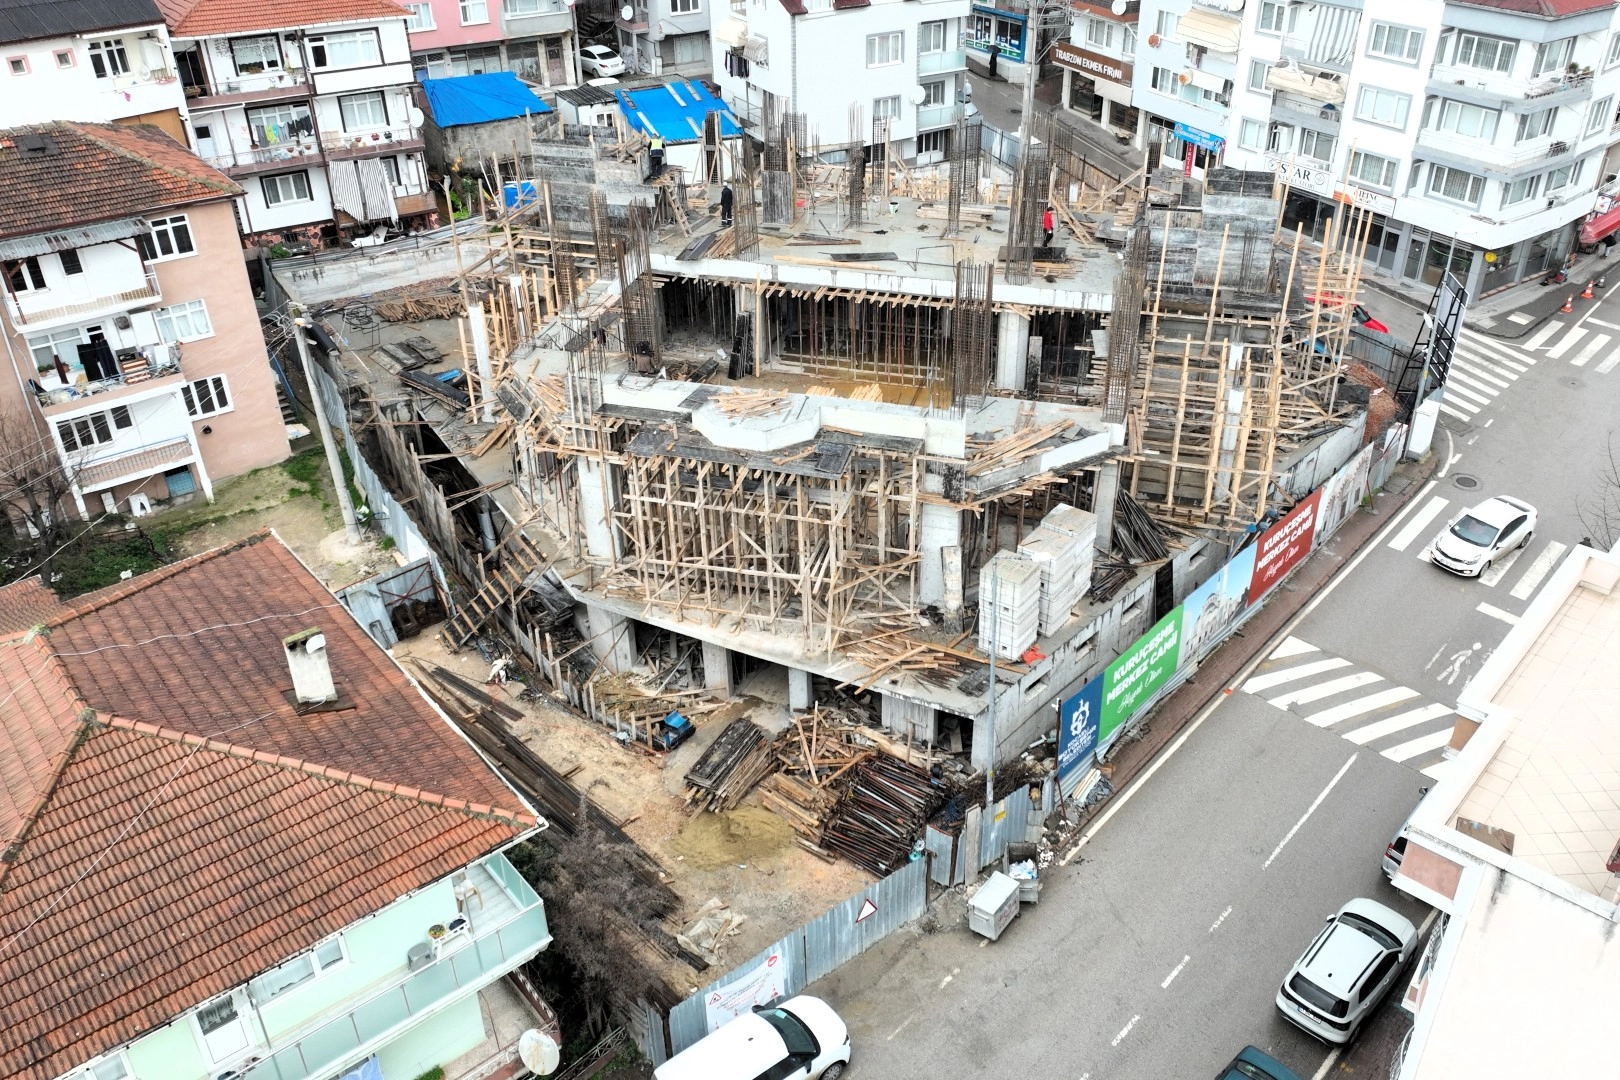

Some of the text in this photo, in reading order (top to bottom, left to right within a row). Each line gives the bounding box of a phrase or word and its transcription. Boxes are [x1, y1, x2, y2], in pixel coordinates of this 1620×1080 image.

[1055, 48, 1082, 66] TRABZON
[1082, 57, 1103, 74] EKMEK
[1263, 503, 1313, 553] KURUÇEŞME
[1256, 535, 1291, 573] MERKEZ
[1113, 619, 1175, 684] KURUÇEŞME
[1106, 658, 1149, 706] MERKEZ
